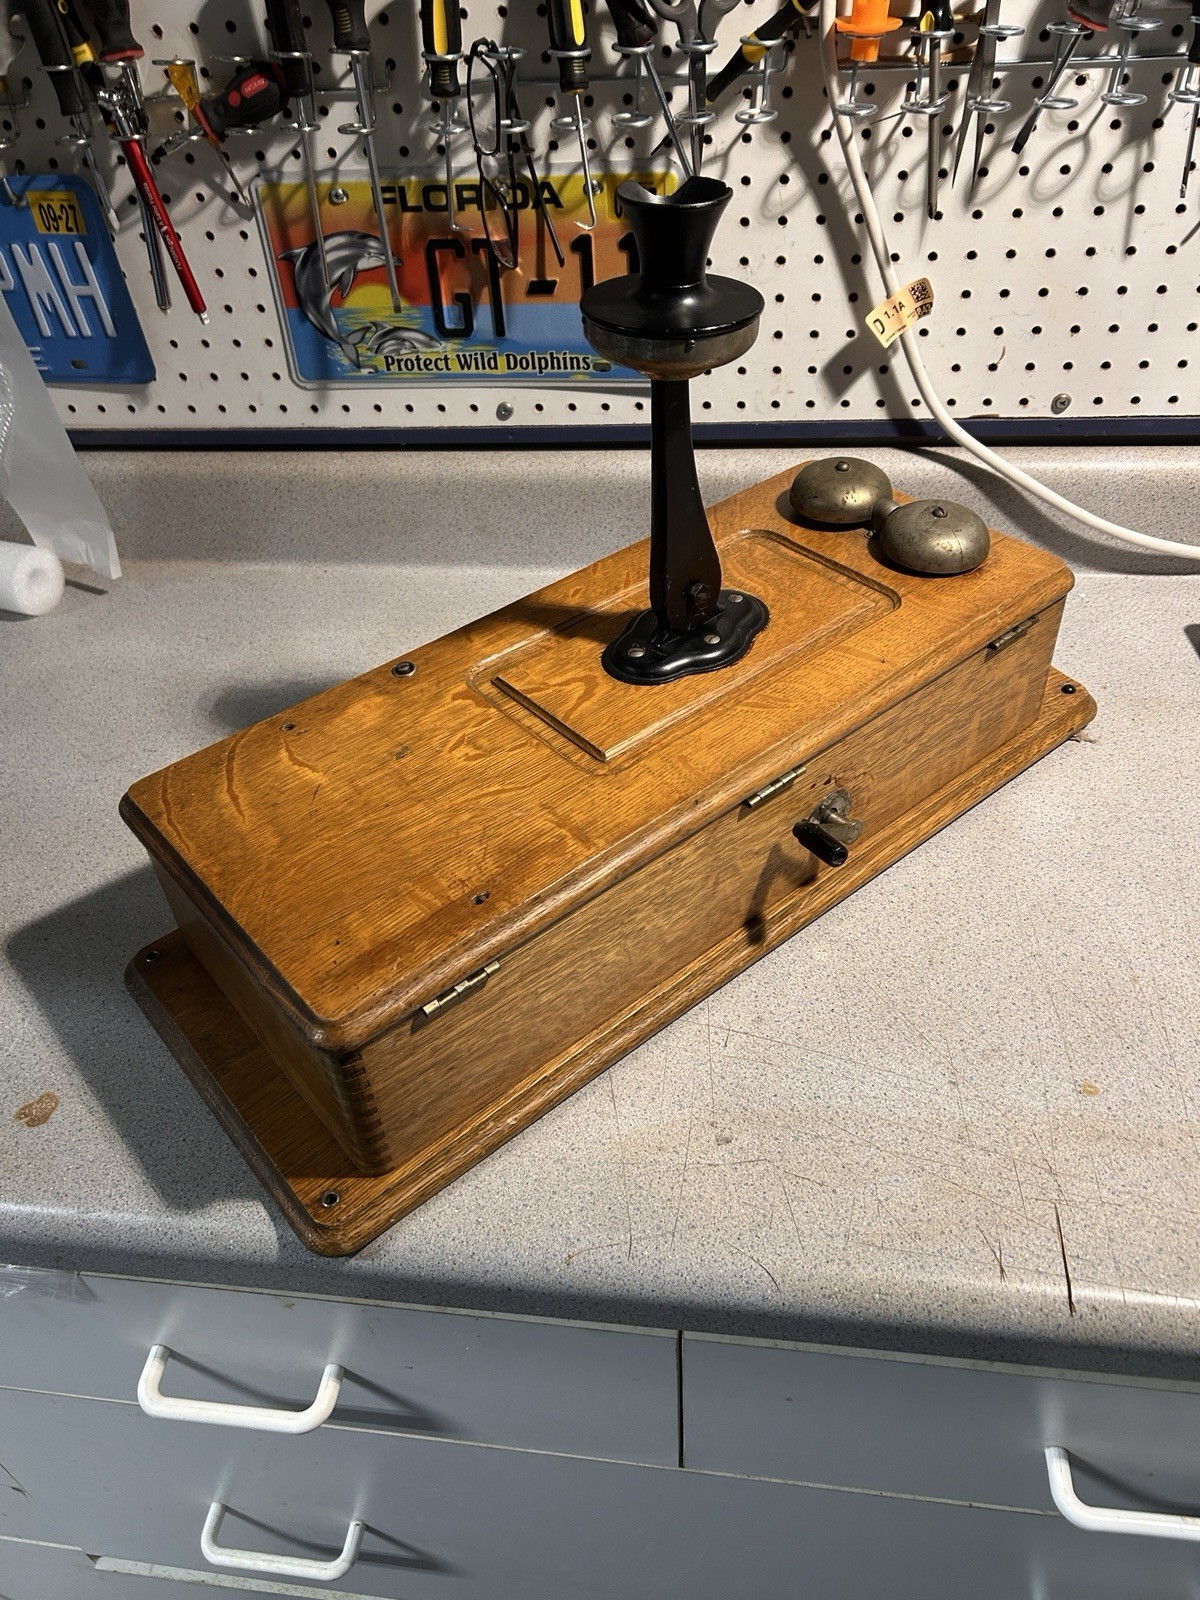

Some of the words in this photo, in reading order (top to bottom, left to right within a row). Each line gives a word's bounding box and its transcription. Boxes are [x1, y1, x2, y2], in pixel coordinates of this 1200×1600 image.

[371, 181, 563, 213] FLORIDA
[38, 203, 80, 233] 09-27
[873, 318, 886, 335] D
[884, 301, 906, 319] 1.1A
[383, 353, 452, 373] Protect
[455, 352, 499, 371] Wild
[505, 351, 591, 375] Dolphins
